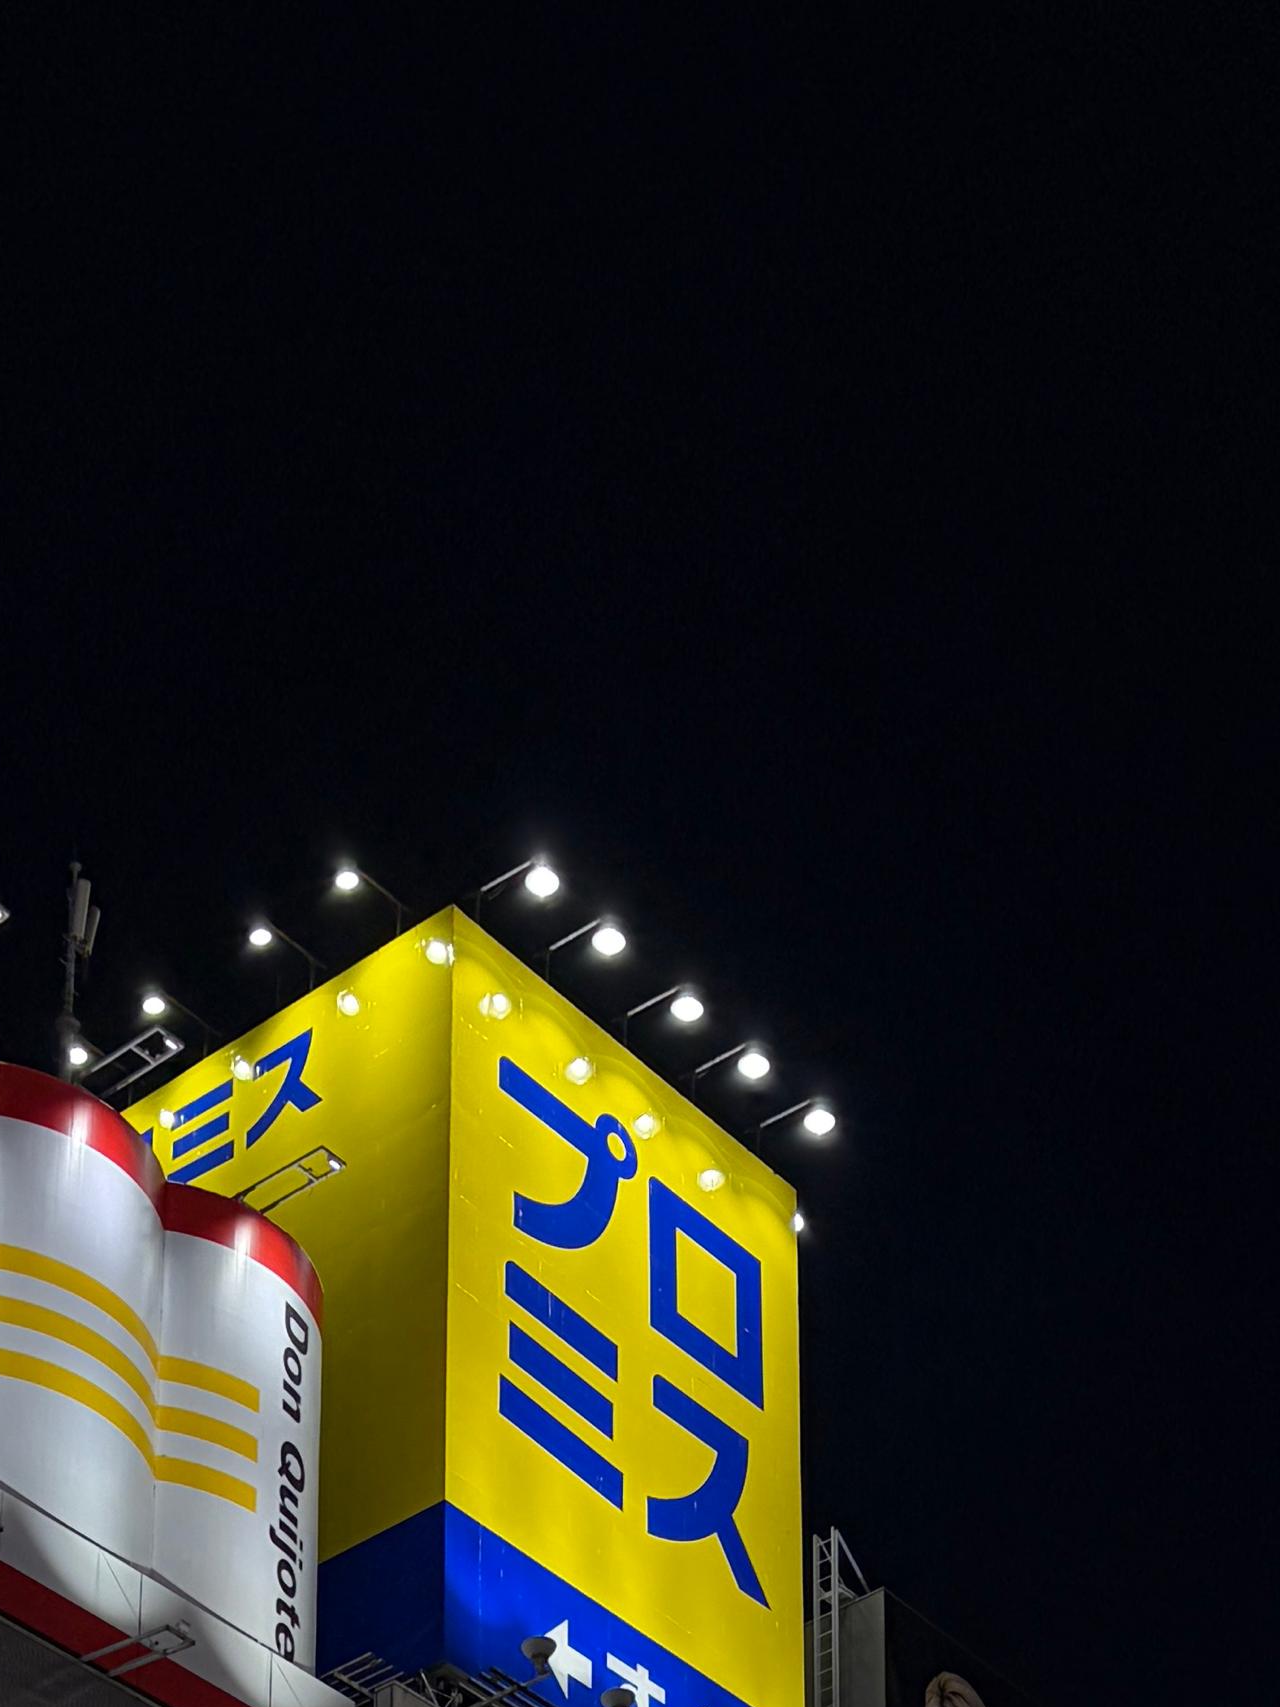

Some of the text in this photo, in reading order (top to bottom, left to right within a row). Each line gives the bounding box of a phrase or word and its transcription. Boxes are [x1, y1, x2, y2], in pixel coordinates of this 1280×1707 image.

[142, 1027, 322, 1183] ミス
[275, 1300, 311, 1662] Don Quijote
